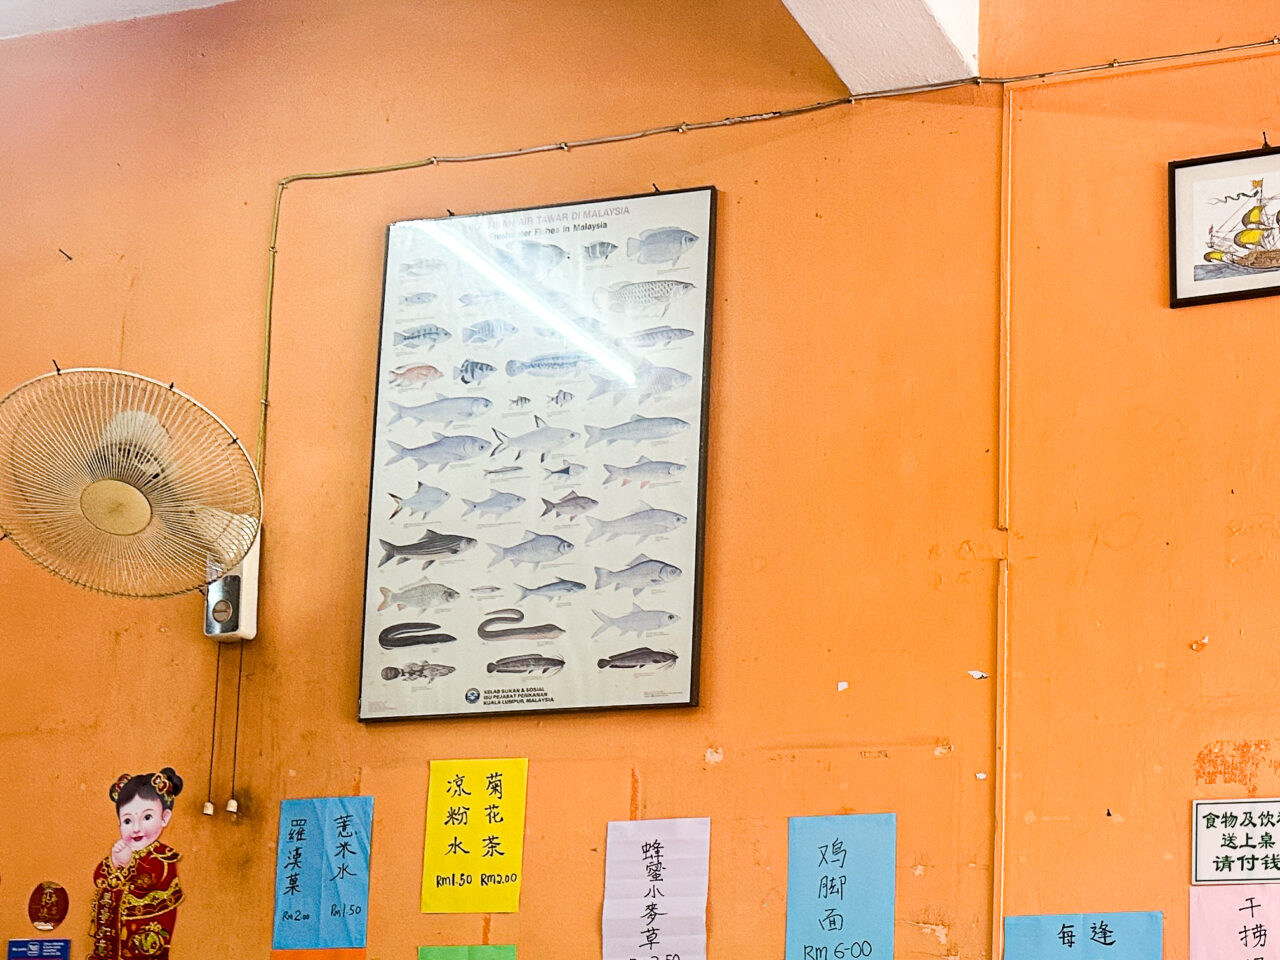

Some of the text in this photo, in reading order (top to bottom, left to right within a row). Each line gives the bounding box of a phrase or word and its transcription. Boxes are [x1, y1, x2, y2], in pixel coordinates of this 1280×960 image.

[537, 212, 568, 225] TAWAR
[571, 211, 580, 221] DI
[583, 205, 630, 219] MALAYSIA
[562, 224, 570, 233] in
[573, 220, 608, 232] Malaysia
[482, 771, 506, 859] 菊花茶
[1220, 831, 1276, 850] 送上桌
[818, 837, 847, 932] 鸡脚面
[1057, 921, 1116, 948] 每逢
